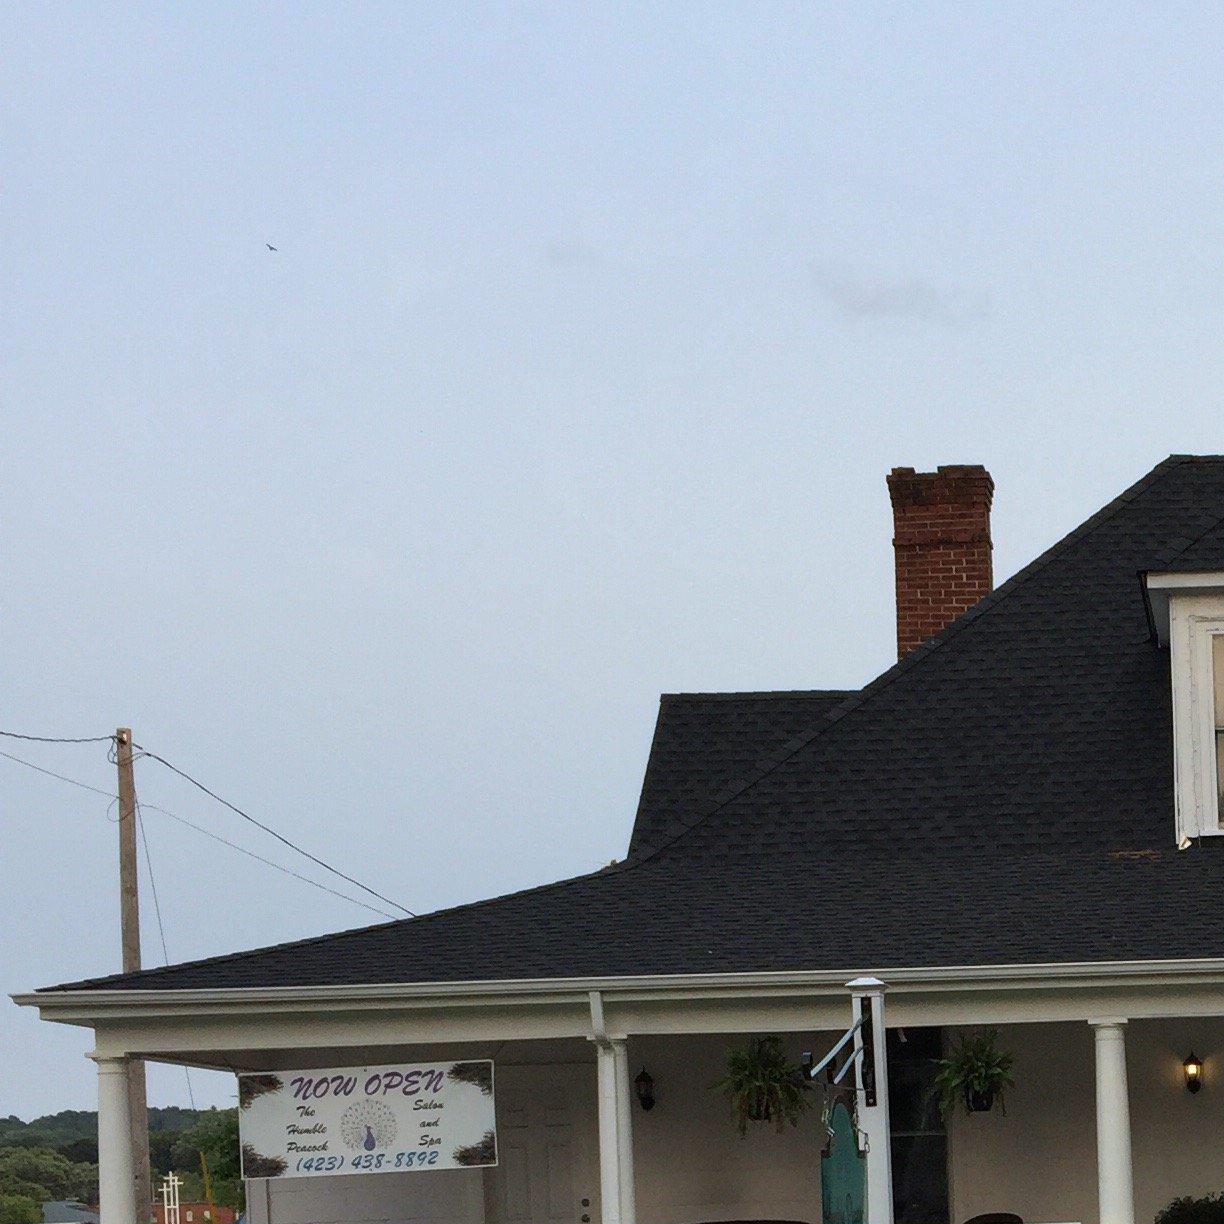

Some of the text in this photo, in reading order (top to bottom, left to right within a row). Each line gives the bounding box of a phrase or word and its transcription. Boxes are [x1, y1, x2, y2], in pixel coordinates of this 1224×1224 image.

[290, 1070, 444, 1100] NOW OPEN
[296, 1106, 316, 1117] The
[413, 1100, 444, 1111] Salon
[420, 1118, 440, 1127] and
[286, 1123, 328, 1135] Humble
[286, 1141, 330, 1153] Peacock
[418, 1135, 442, 1148] Spa
[296, 1151, 439, 1172] (423) 438-8892
